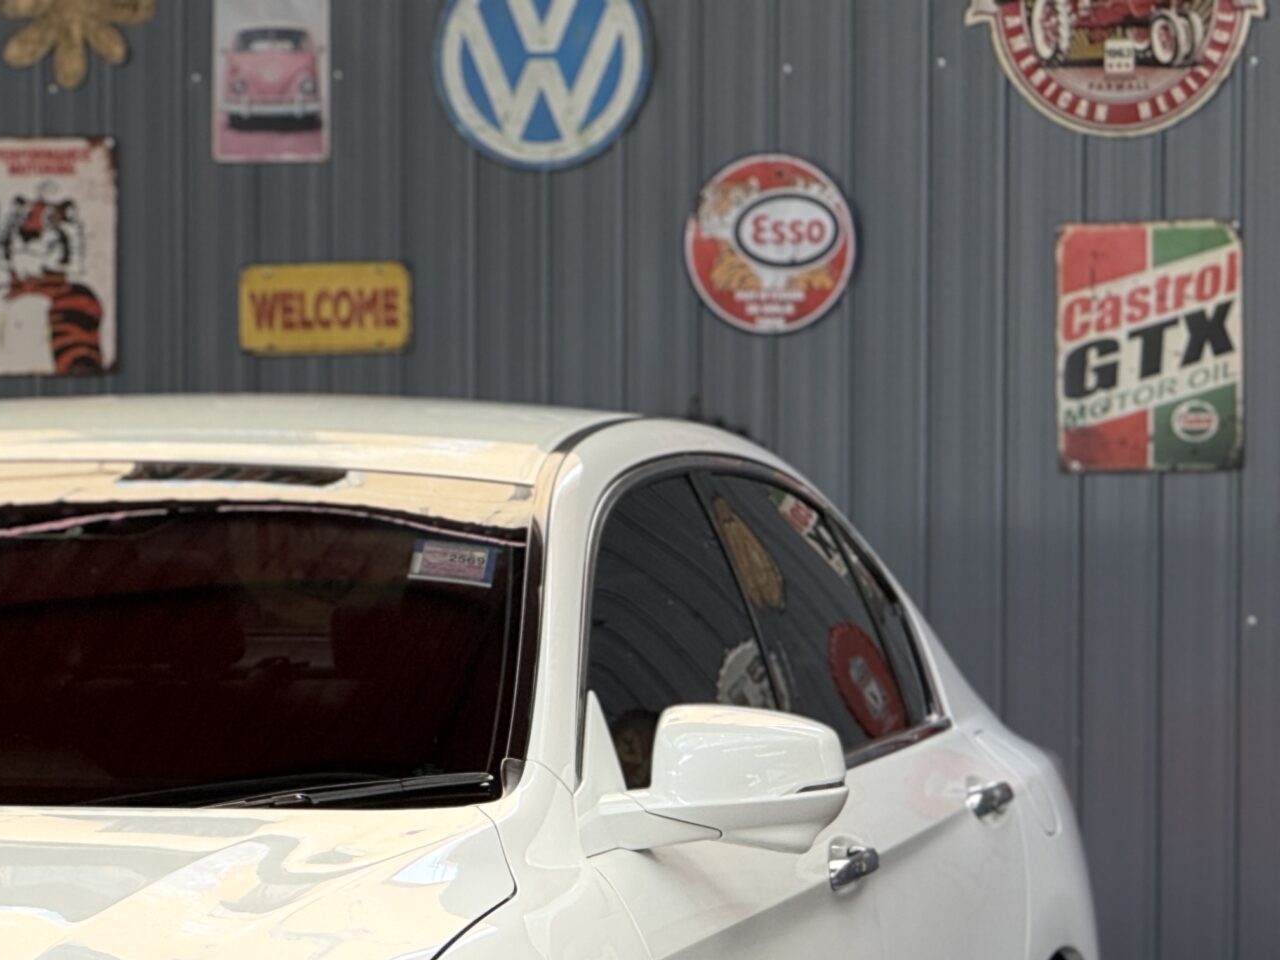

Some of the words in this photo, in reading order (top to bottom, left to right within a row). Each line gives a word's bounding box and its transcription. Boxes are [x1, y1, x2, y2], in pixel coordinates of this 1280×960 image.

[1003, 14, 1109, 123] AMERICAN
[1136, 11, 1236, 121] HERITAGE
[250, 287, 400, 332] WELCOME
[1062, 251, 1238, 343] Castrol
[1063, 301, 1235, 400] GTX
[1064, 378, 1177, 428] MOTOR
[1188, 362, 1232, 390] OIL
